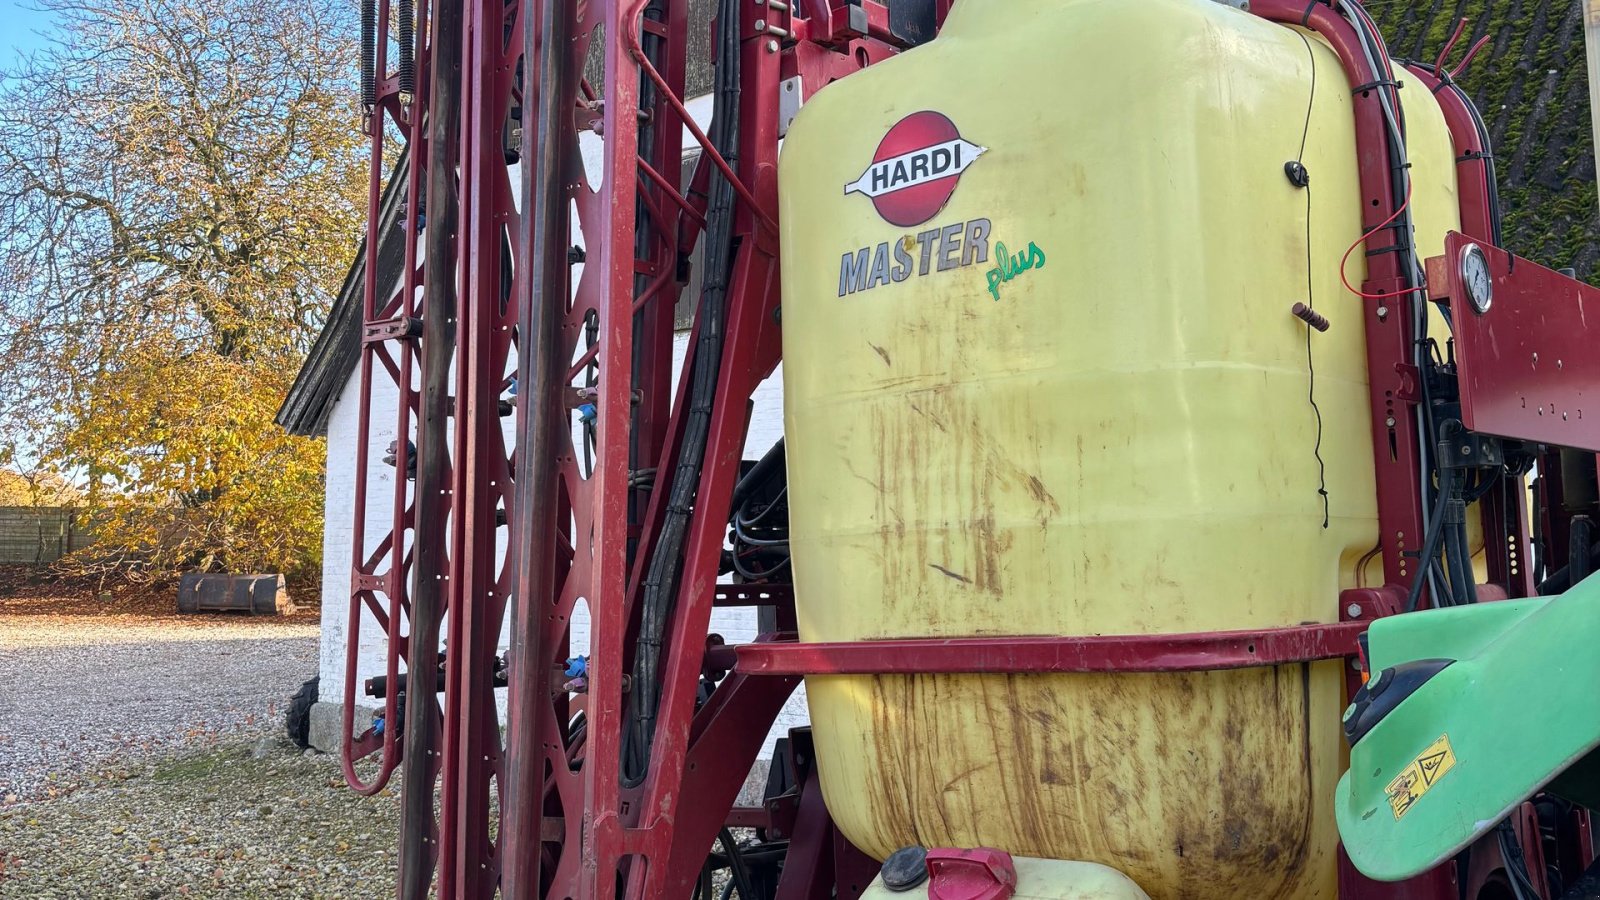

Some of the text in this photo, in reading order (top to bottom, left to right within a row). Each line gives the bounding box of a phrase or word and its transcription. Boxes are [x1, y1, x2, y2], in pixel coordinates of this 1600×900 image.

[872, 144, 961, 192] HARDI
[838, 218, 1046, 301] MASTER plus
